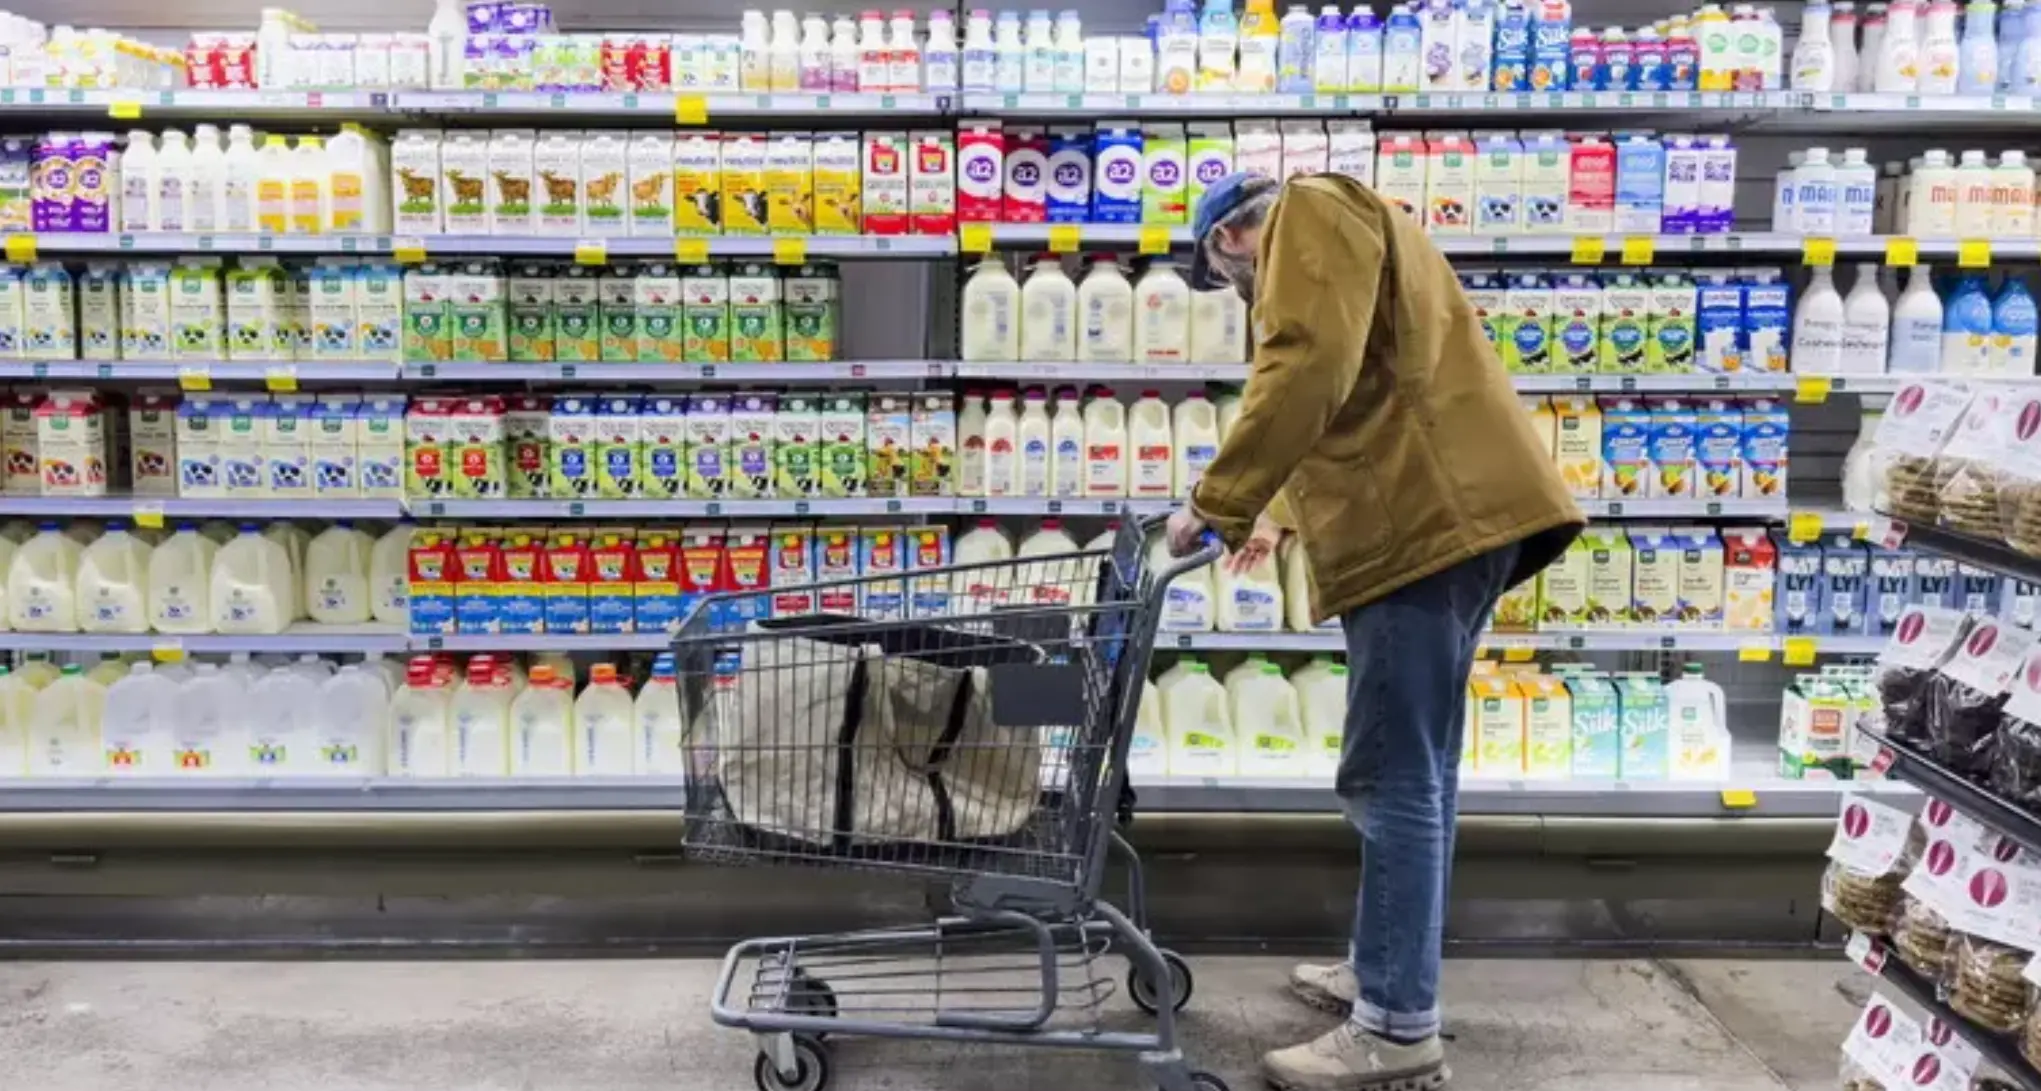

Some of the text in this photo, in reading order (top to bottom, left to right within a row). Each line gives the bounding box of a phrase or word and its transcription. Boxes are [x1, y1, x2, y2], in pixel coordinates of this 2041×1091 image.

[970, 163, 992, 176] a2
[1015, 167, 1037, 181] a2
[1056, 168, 1079, 181] a2
[1109, 162, 1132, 176] a2
[1153, 165, 1175, 180] a2
[1198, 163, 1222, 178] a2
[1576, 706, 1618, 736] Silk
[1623, 706, 1668, 737] Silk
